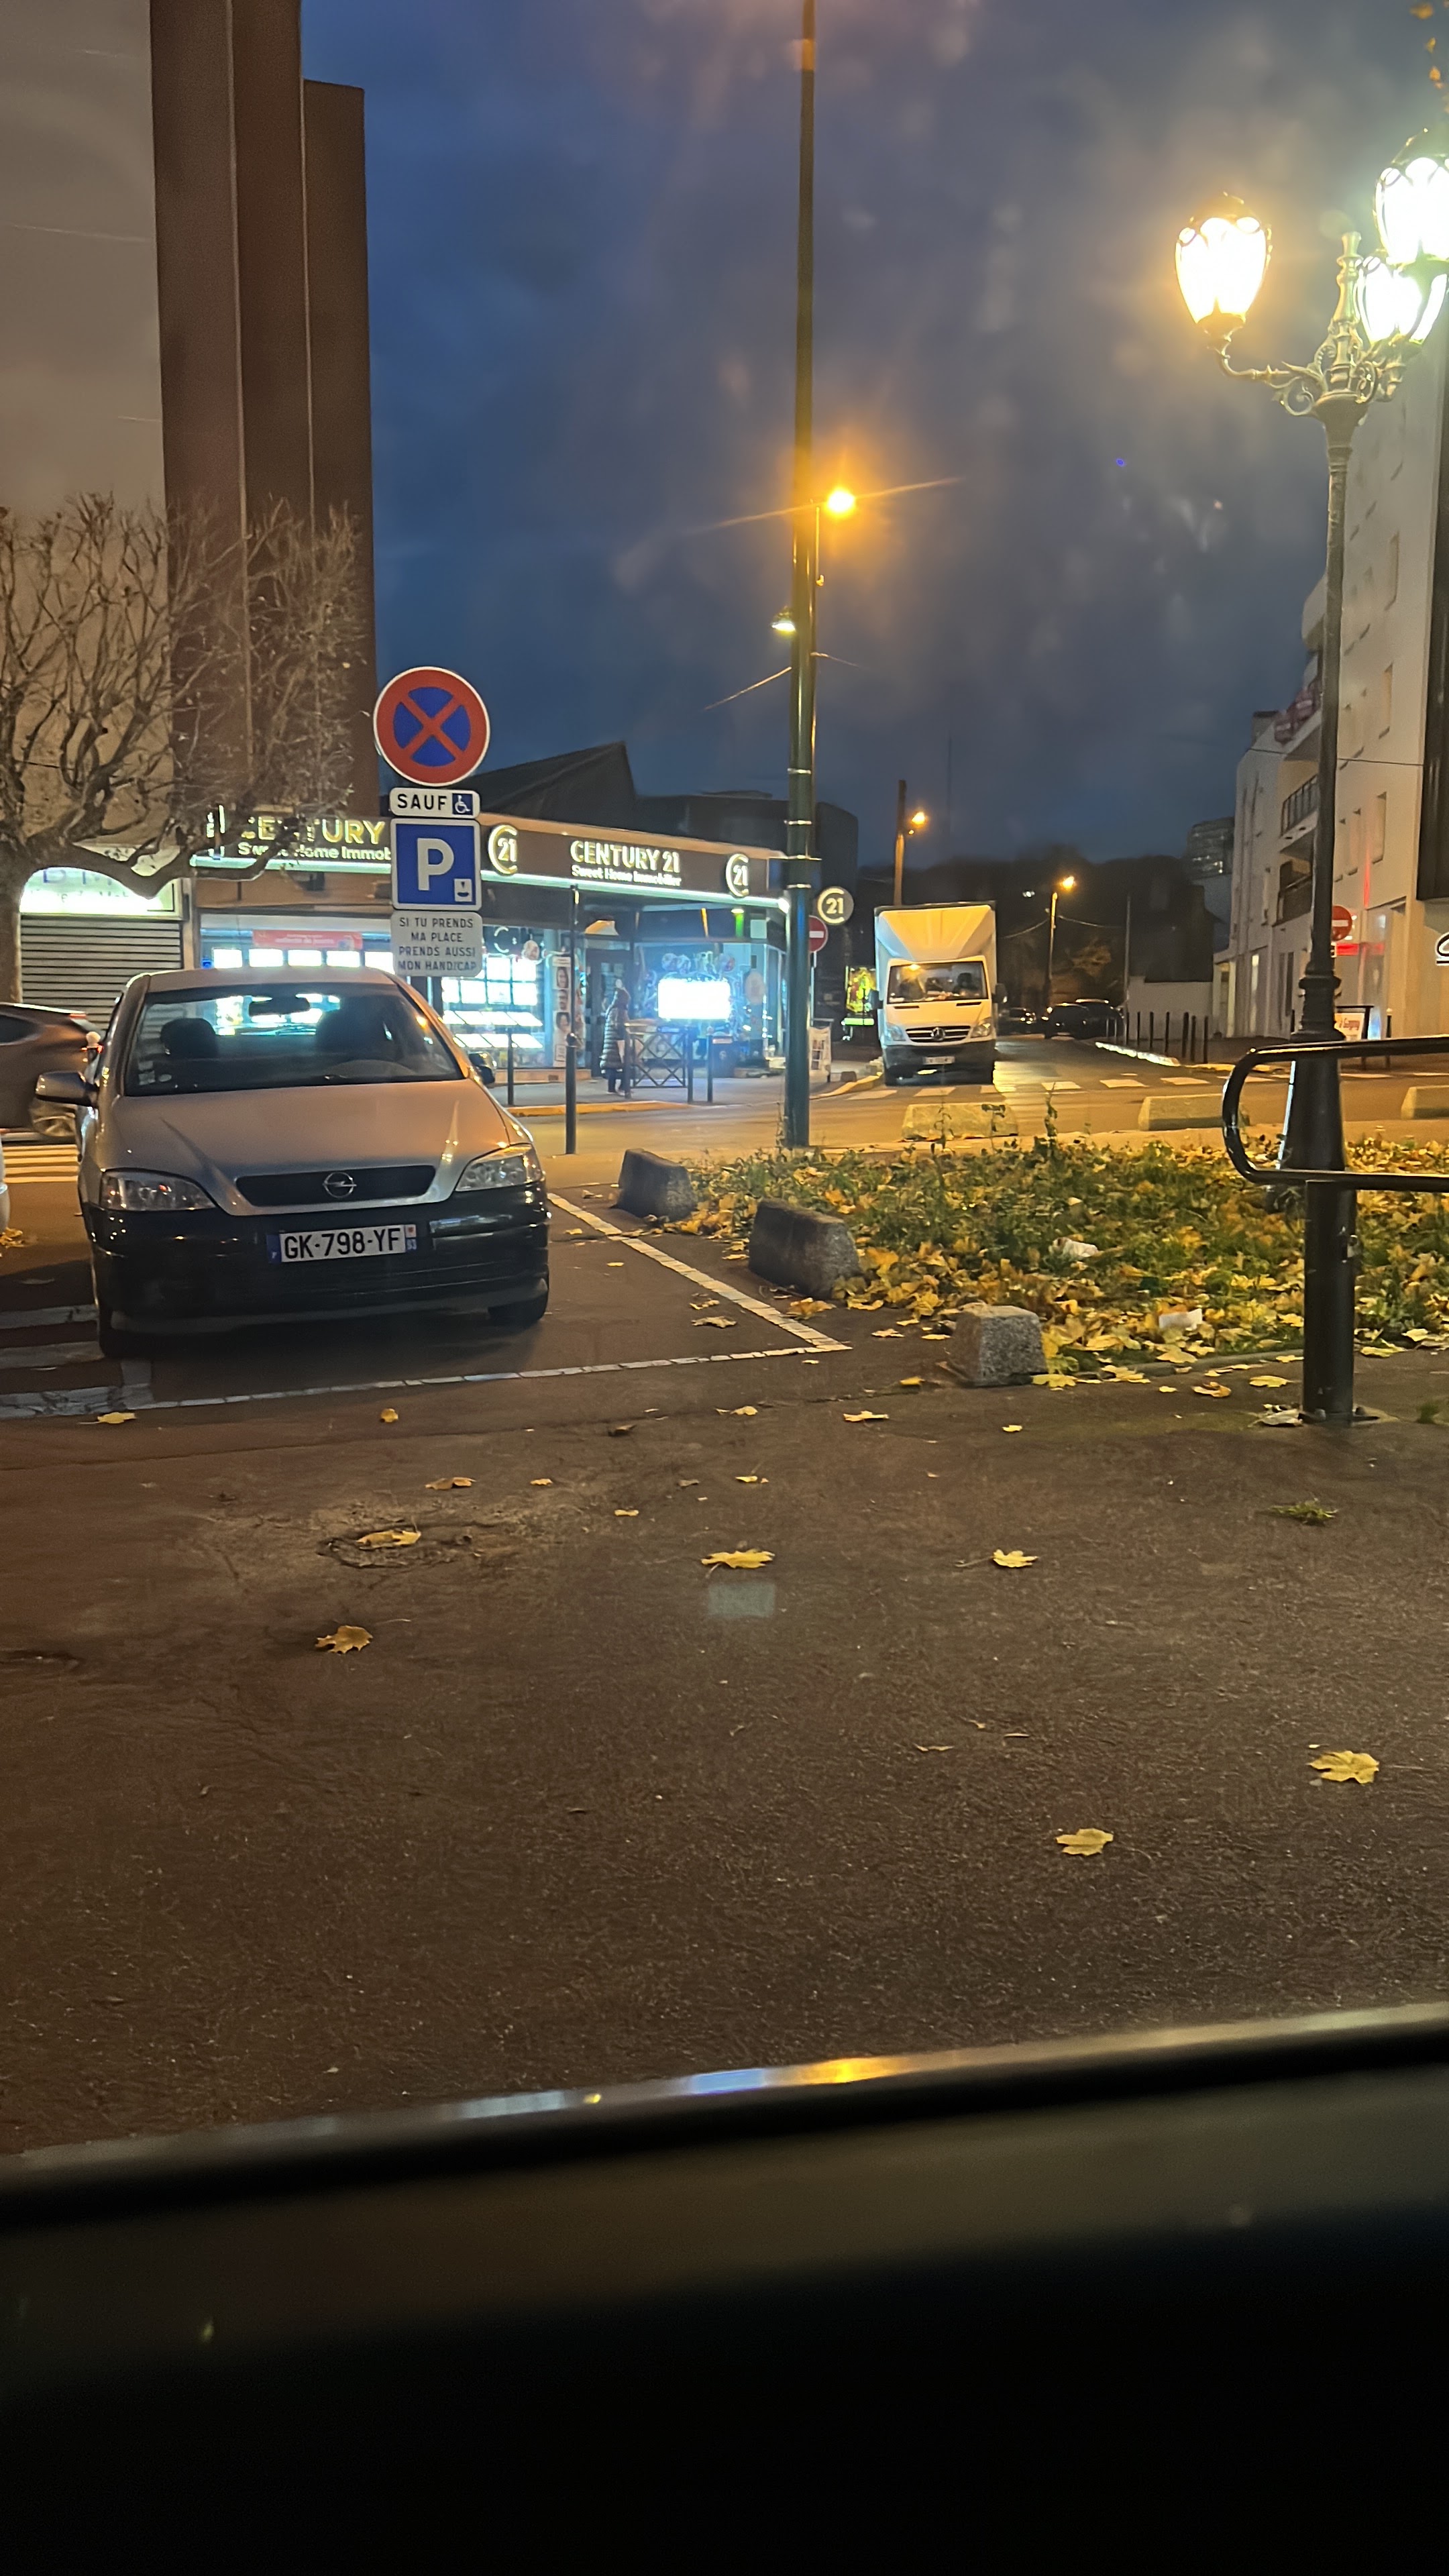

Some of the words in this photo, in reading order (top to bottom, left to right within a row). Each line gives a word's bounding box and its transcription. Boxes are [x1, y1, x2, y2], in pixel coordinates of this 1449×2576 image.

[397, 794, 447, 810] SAUF
[570, 840, 660, 871] CENTURY
[662, 851, 680, 873] 21
[417, 838, 454, 891] P
[399, 917, 409, 927] SI
[415, 918, 427, 927] TU
[432, 918, 474, 928] PRENDS
[411, 932, 426, 941] MA
[431, 932, 464, 943] PLACE
[398, 946, 440, 957] PRENDS
[445, 947, 476, 957] AUSSI
[398, 960, 421, 970] MON
[425, 961, 478, 971] HANDICAP
[284, 1228, 401, 1259] GK-798-YF
